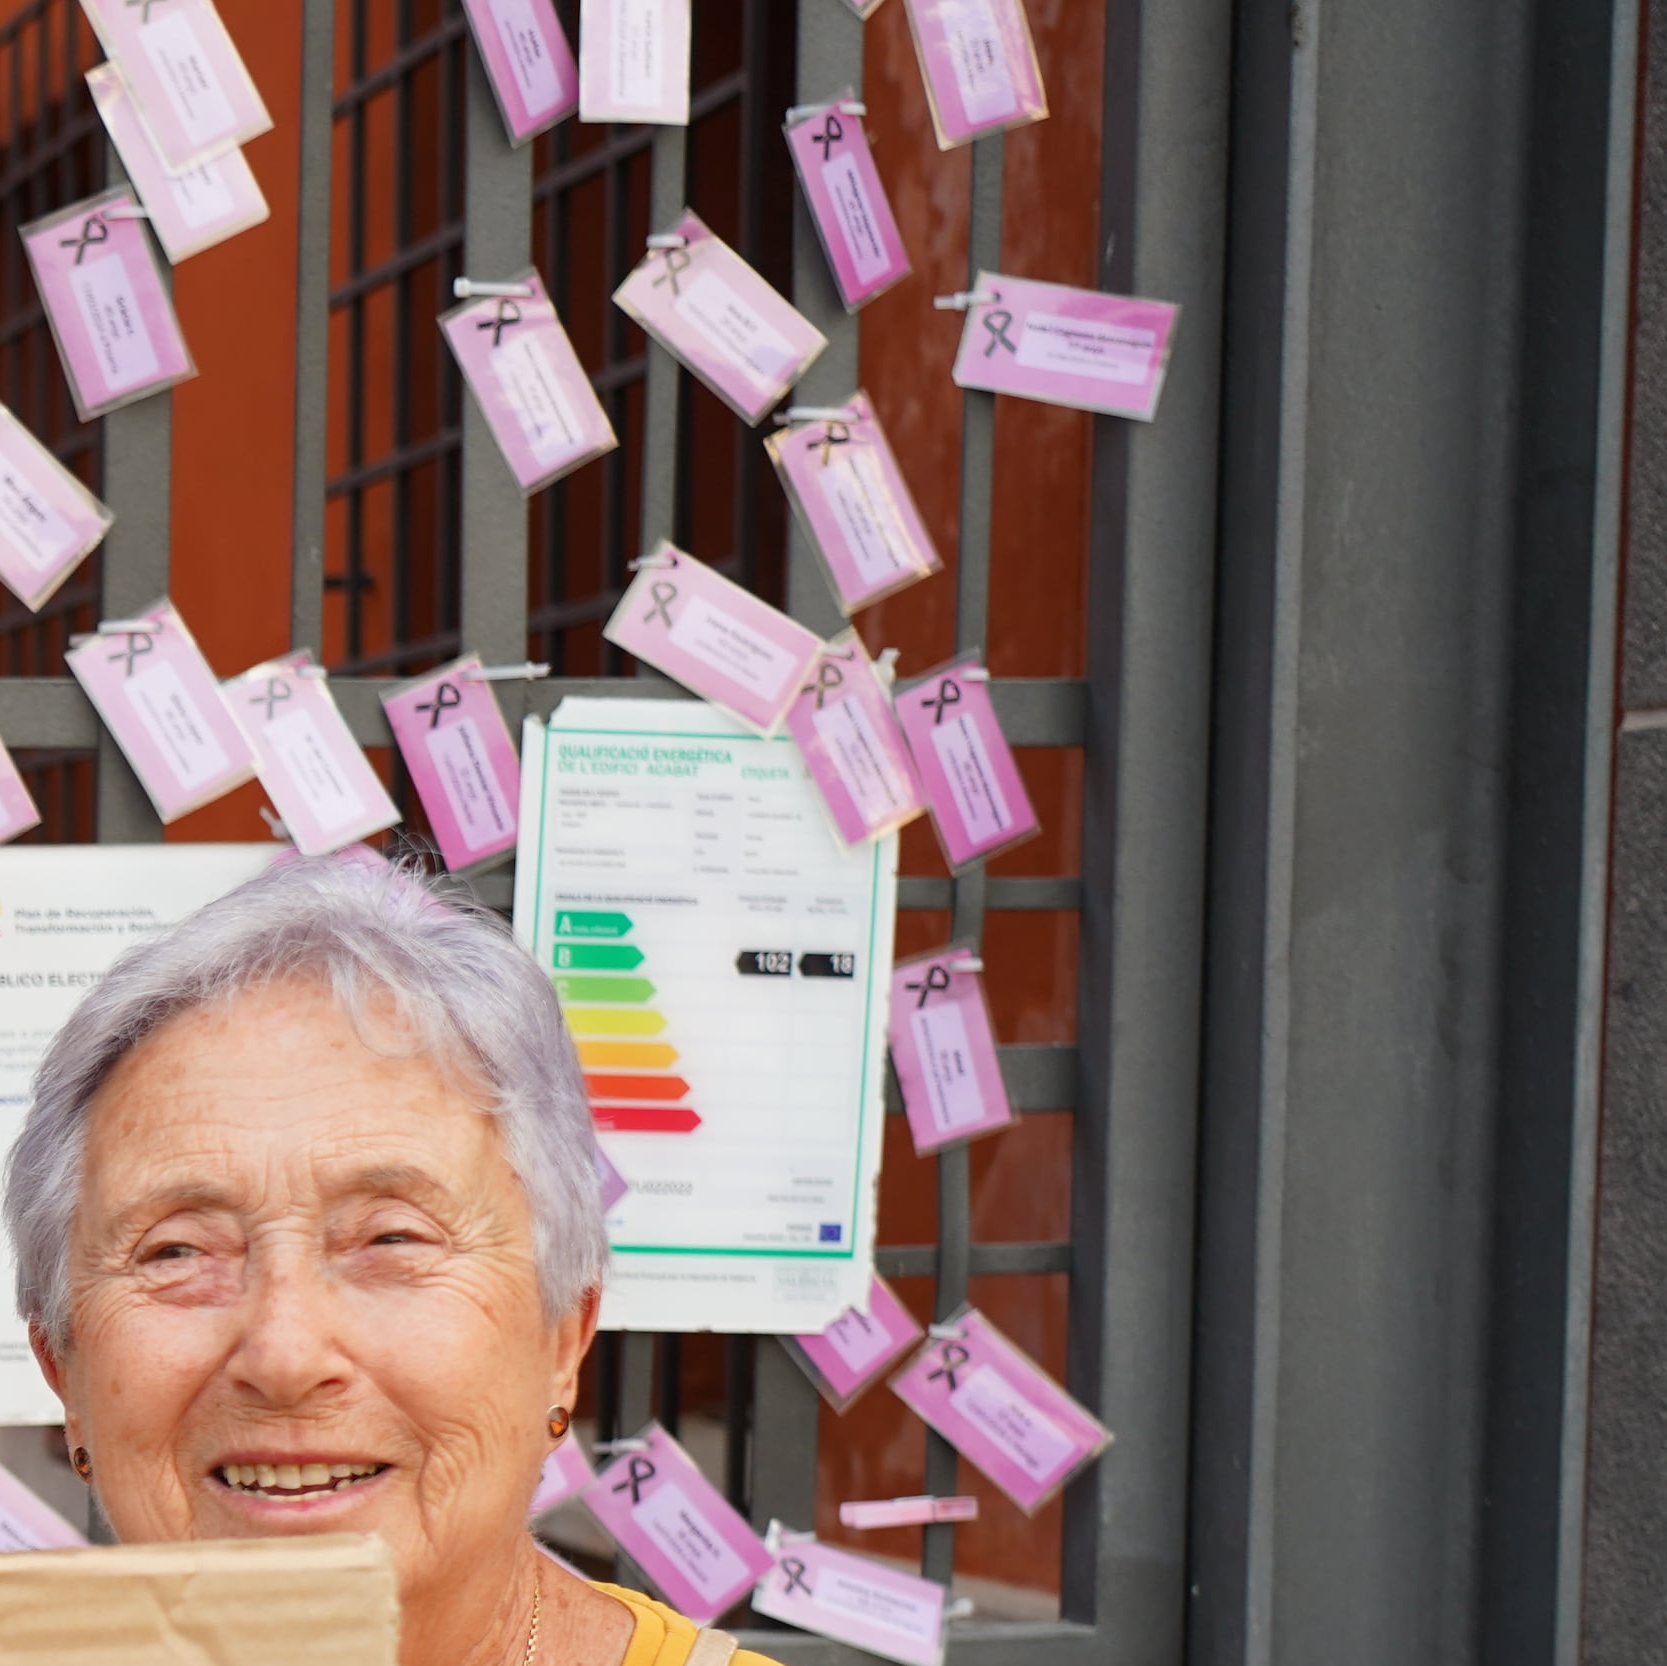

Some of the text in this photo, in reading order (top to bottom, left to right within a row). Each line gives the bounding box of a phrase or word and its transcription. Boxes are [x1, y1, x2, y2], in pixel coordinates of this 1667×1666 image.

[558, 743, 733, 764] QUALIFICACIÓ ENERGÈTICA
[558, 761, 791, 781] DE L'EDIFICI ACABAT ETIQUETA
[559, 914, 573, 935] A
[558, 947, 853, 976] B 102 18
